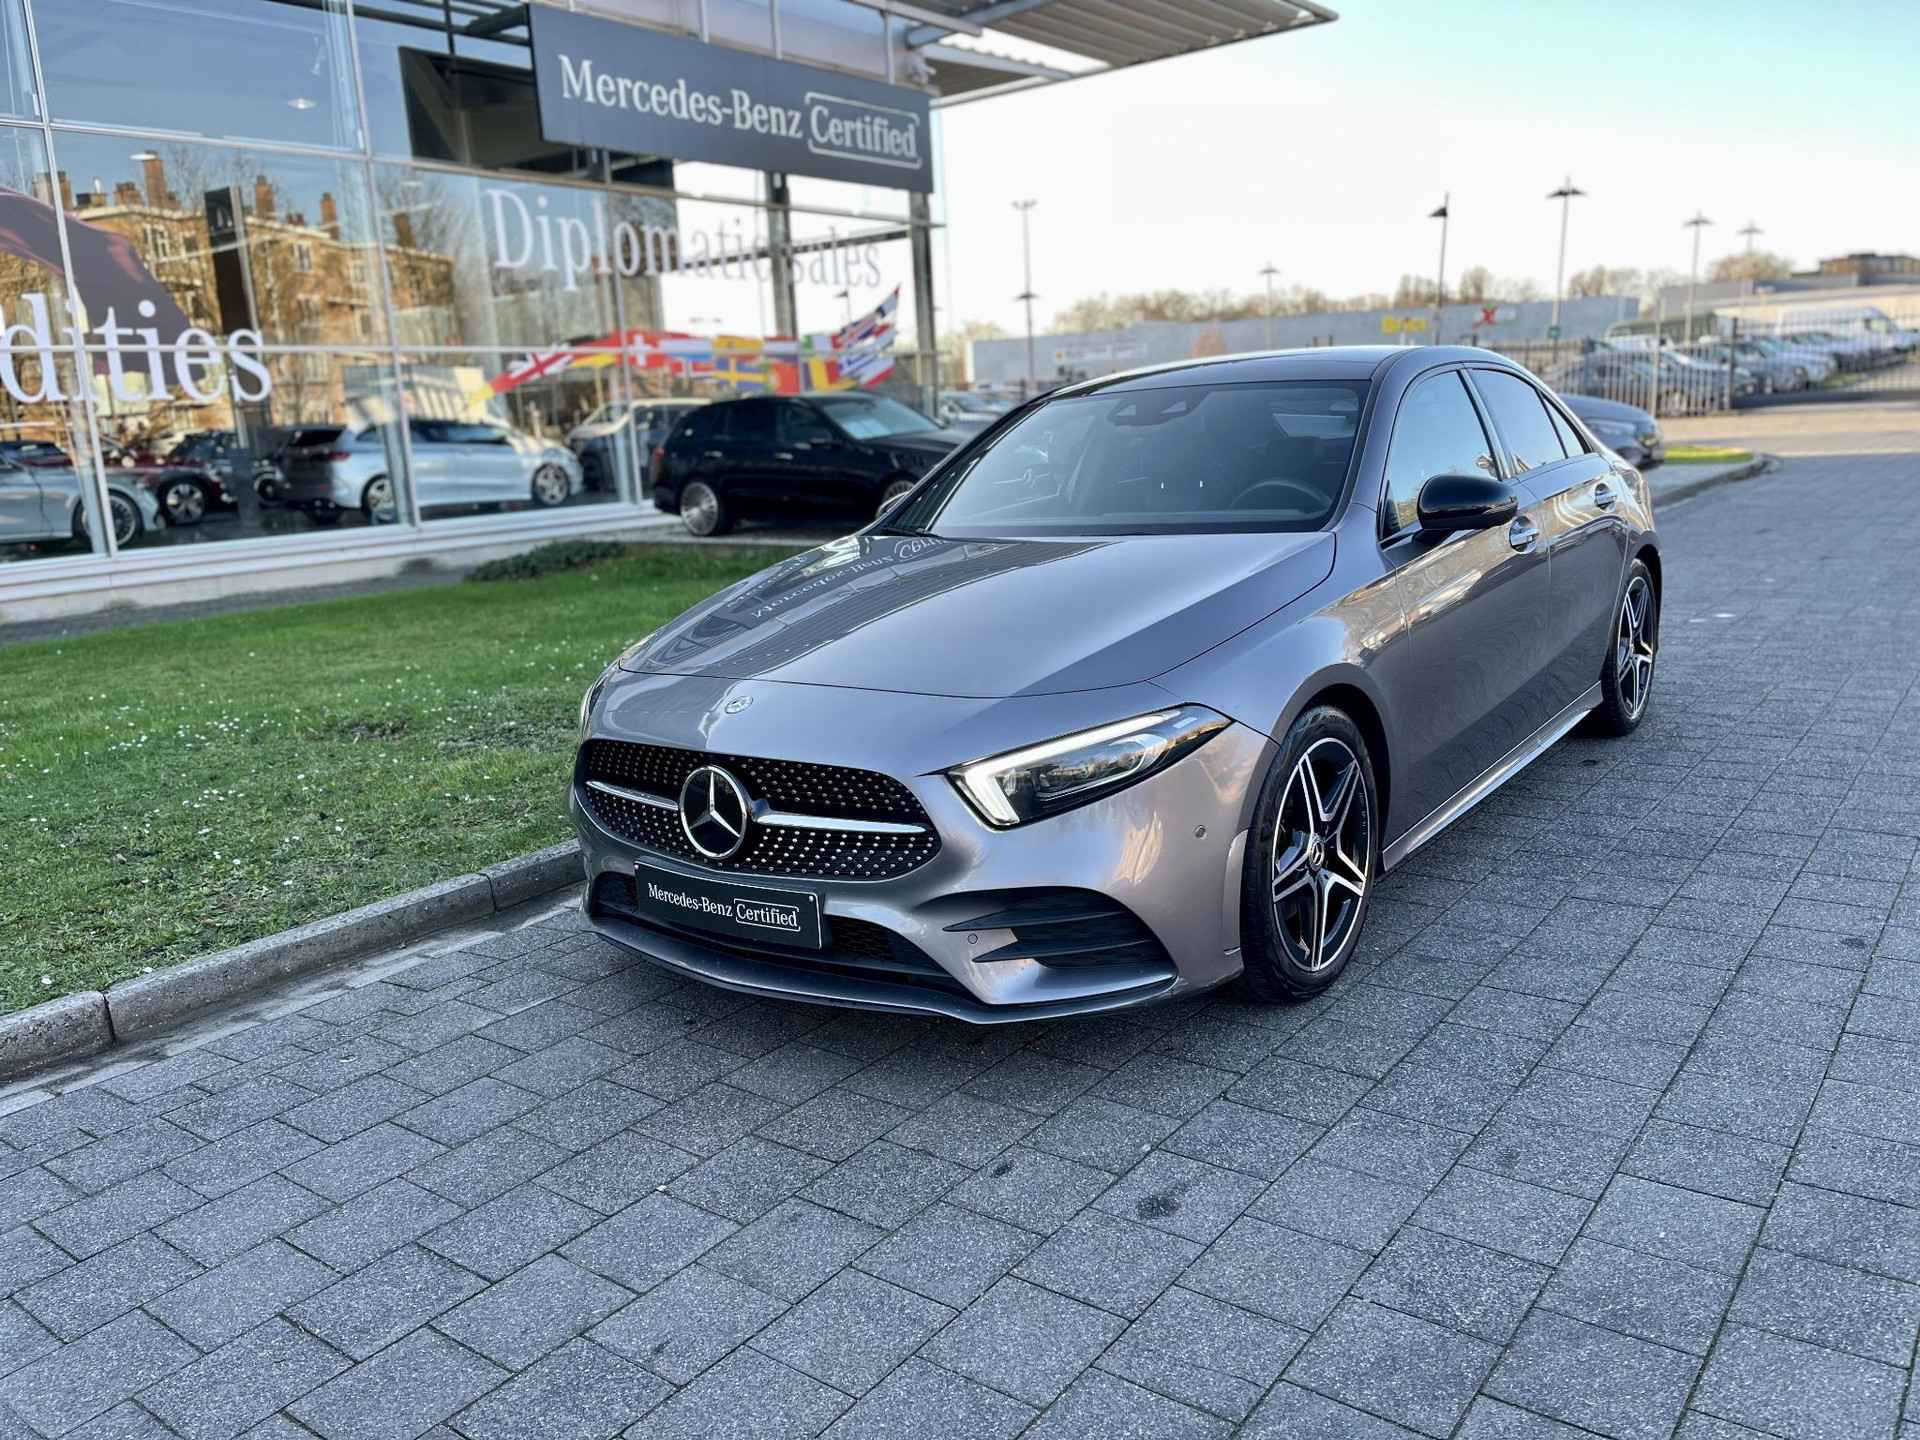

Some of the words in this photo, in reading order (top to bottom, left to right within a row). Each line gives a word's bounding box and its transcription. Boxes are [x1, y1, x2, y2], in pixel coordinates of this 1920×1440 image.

[557, 54, 803, 139] Mercedes-Benz
[810, 104, 918, 159] Certified
[486, 189, 769, 292] Diplomatic
[647, 882, 733, 917] Mercedes-Benz
[736, 903, 798, 927] Certified
